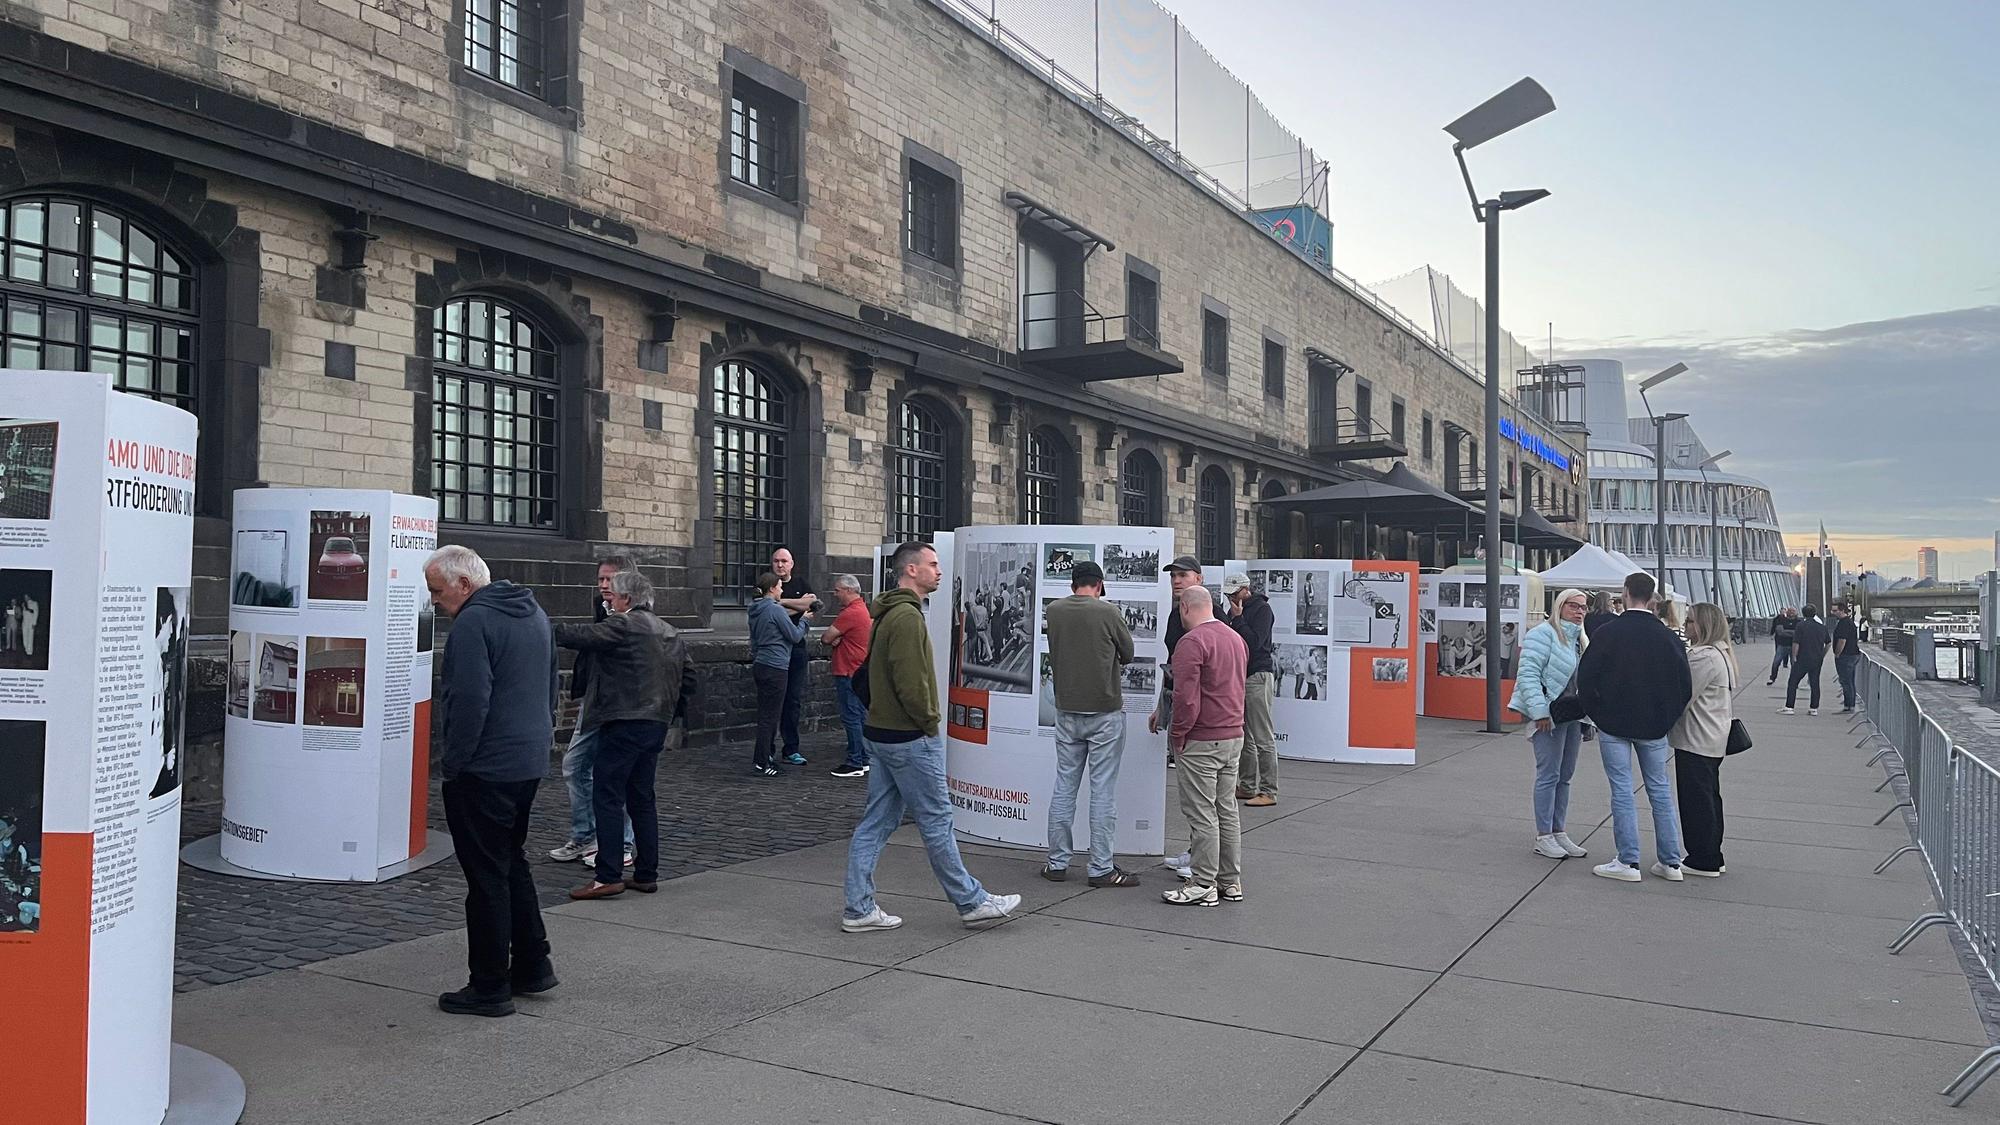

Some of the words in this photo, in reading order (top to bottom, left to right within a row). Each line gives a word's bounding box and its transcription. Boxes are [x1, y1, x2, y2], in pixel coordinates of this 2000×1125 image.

[144, 444, 164, 474] UND
[168, 449, 180, 478] DIE
[391, 533, 424, 550] FLÜCHTETE
[974, 800, 1027, 821] DDR-FUSSBALL
